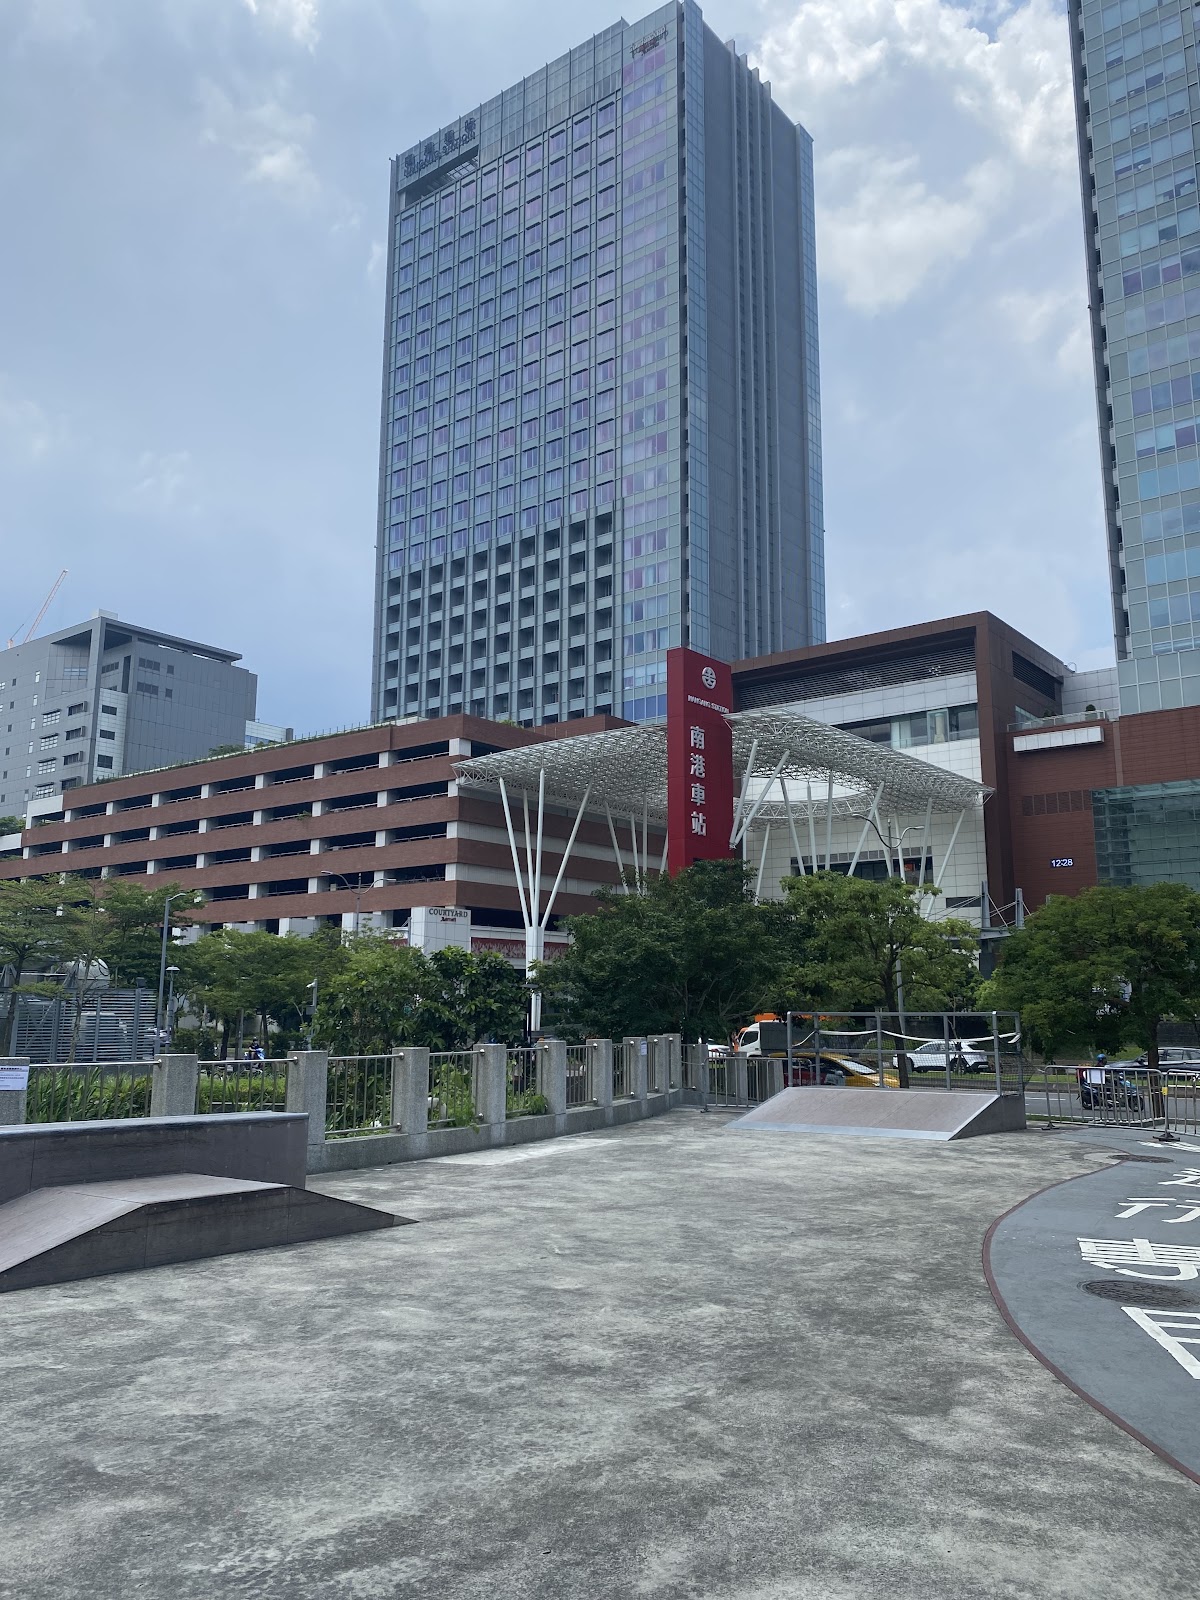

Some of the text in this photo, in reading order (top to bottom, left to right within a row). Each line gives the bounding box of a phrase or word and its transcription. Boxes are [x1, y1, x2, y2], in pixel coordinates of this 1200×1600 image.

[690, 725, 707, 837] 南港車站
[1051, 858, 1074, 868] 12:28
[428, 908, 468, 918] COURTYARD
